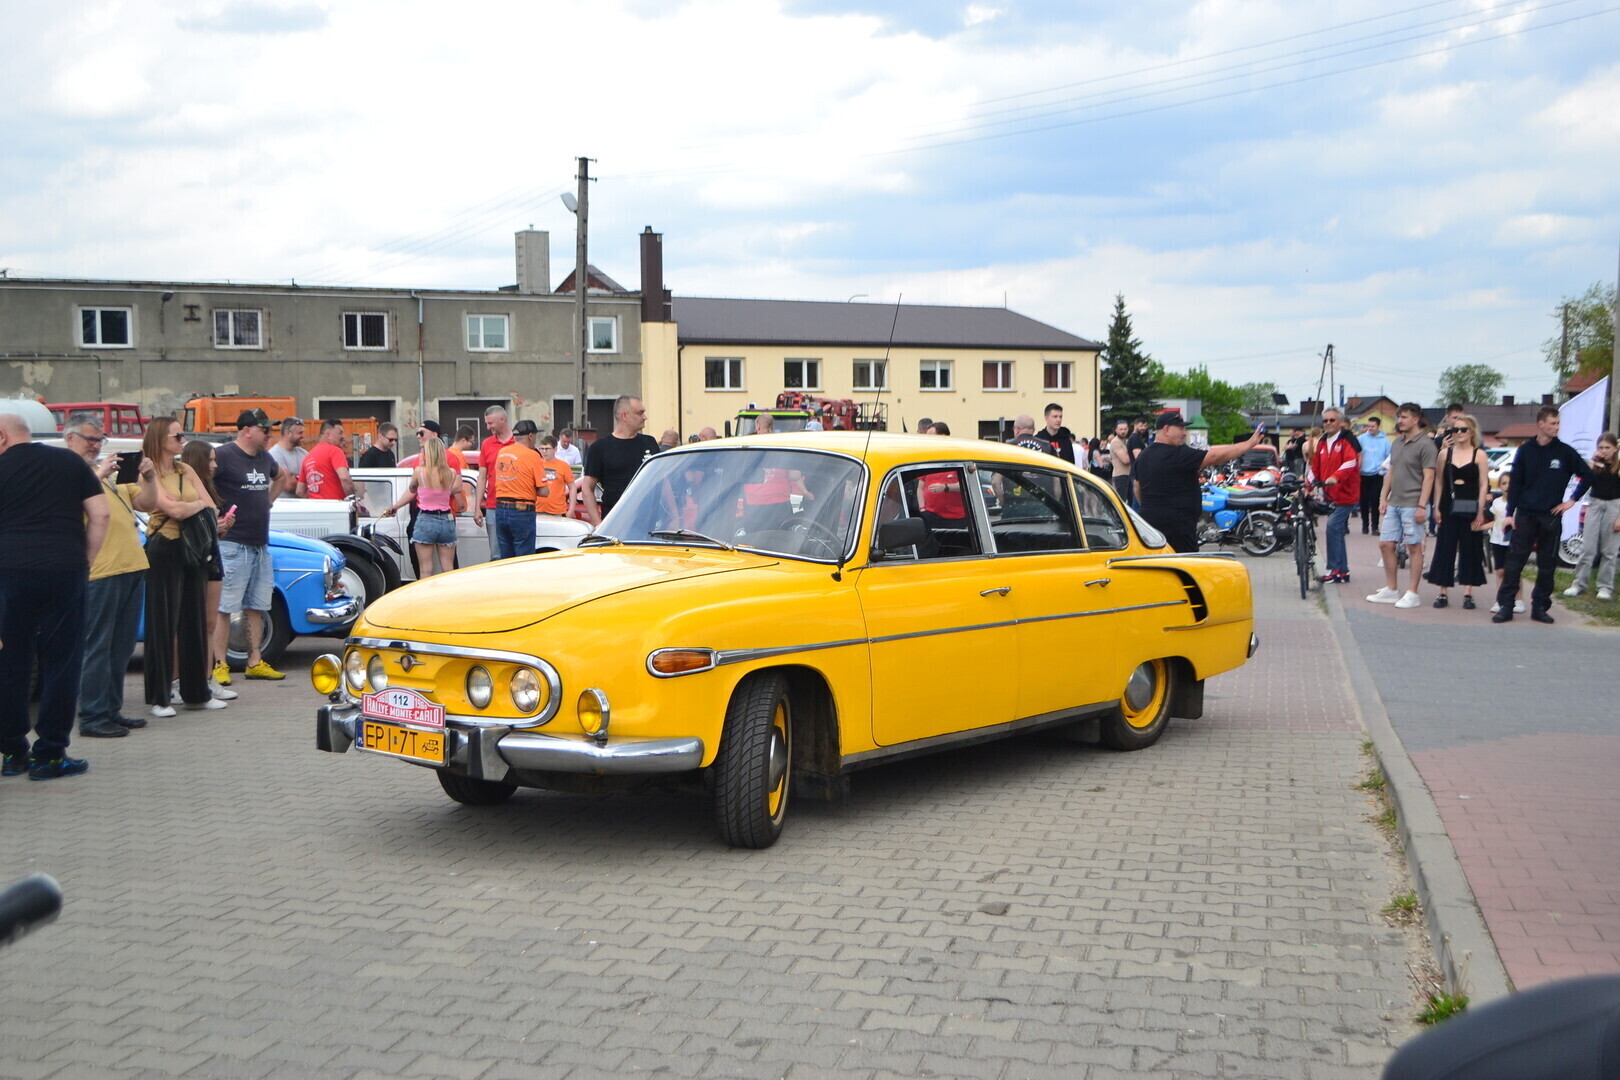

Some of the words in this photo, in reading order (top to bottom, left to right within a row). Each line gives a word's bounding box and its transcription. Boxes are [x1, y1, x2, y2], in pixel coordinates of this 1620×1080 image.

[367, 697, 389, 715] RALLYE
[389, 708, 439, 724] MONTE-CARLO
[393, 694, 409, 706] 112
[400, 730, 418, 755] 7T
